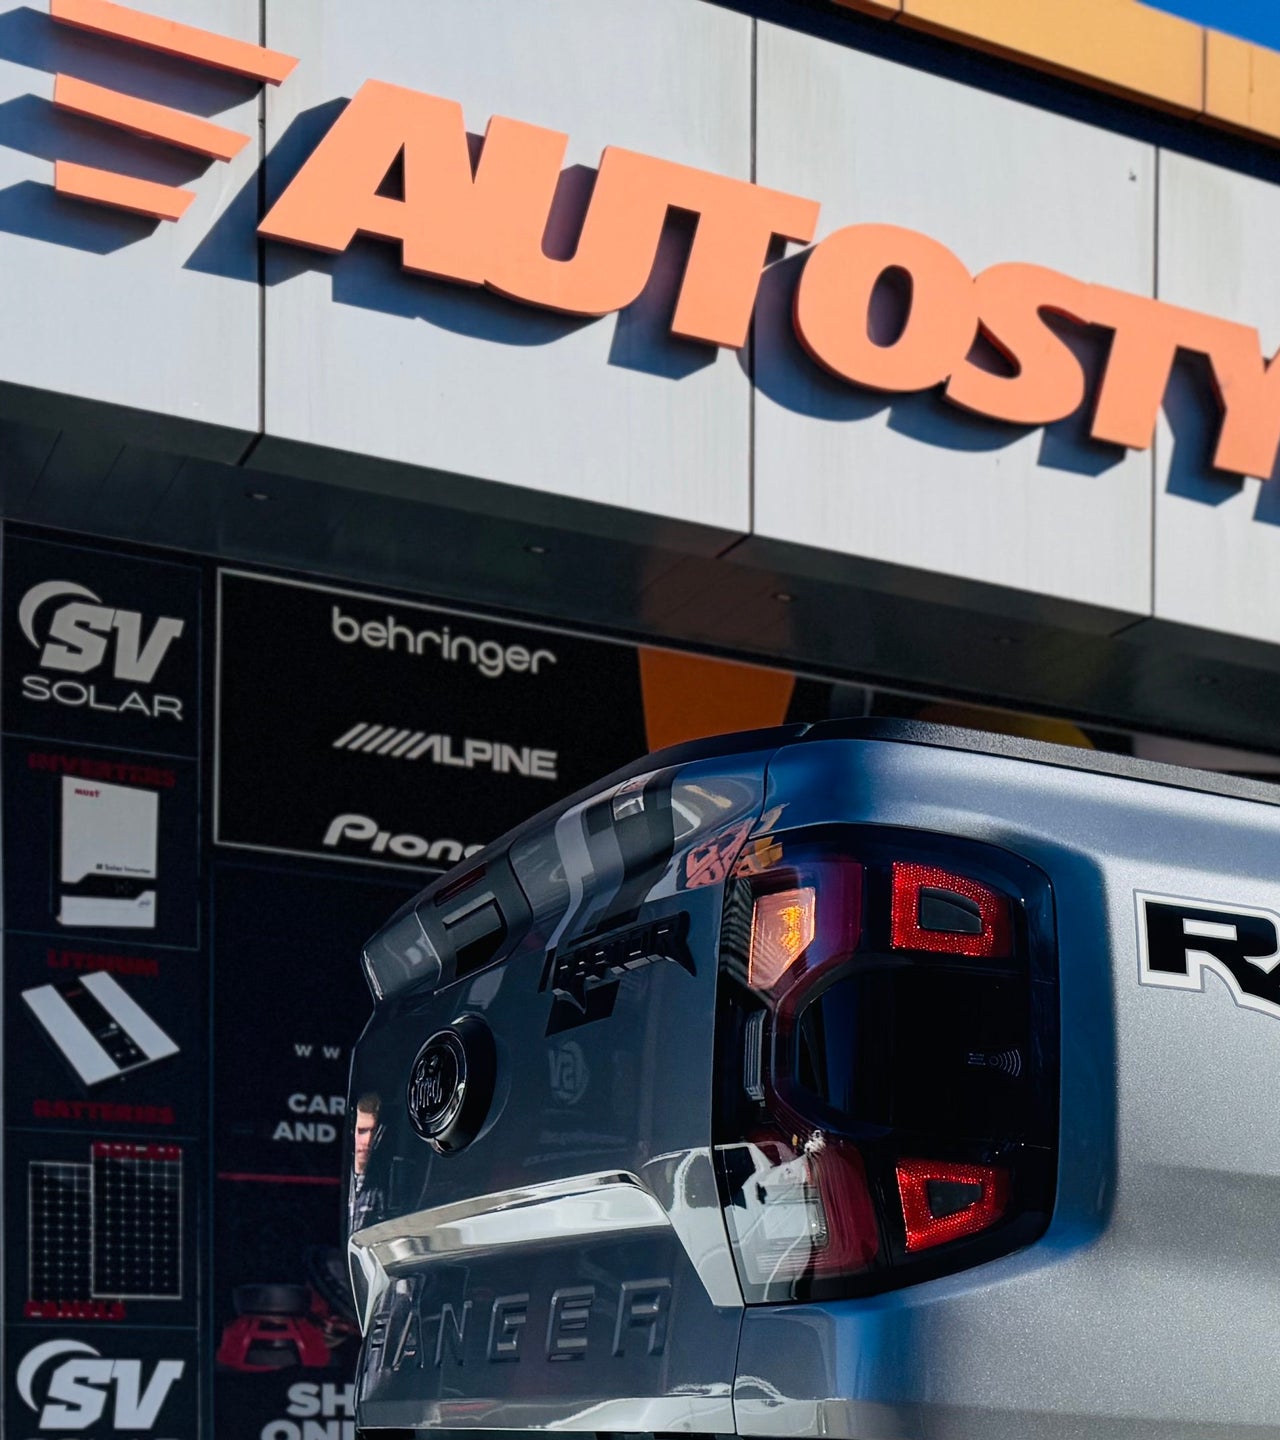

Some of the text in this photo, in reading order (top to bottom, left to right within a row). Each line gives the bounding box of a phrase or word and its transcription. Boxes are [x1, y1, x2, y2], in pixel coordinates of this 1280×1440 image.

[40, 601, 185, 683] SV
[331, 605, 558, 678] behringer
[20, 674, 184, 721] SOLAR
[402, 732, 558, 780] ALPINE
[272, 1121, 337, 1144] AND
[39, 1358, 185, 1430] SV
